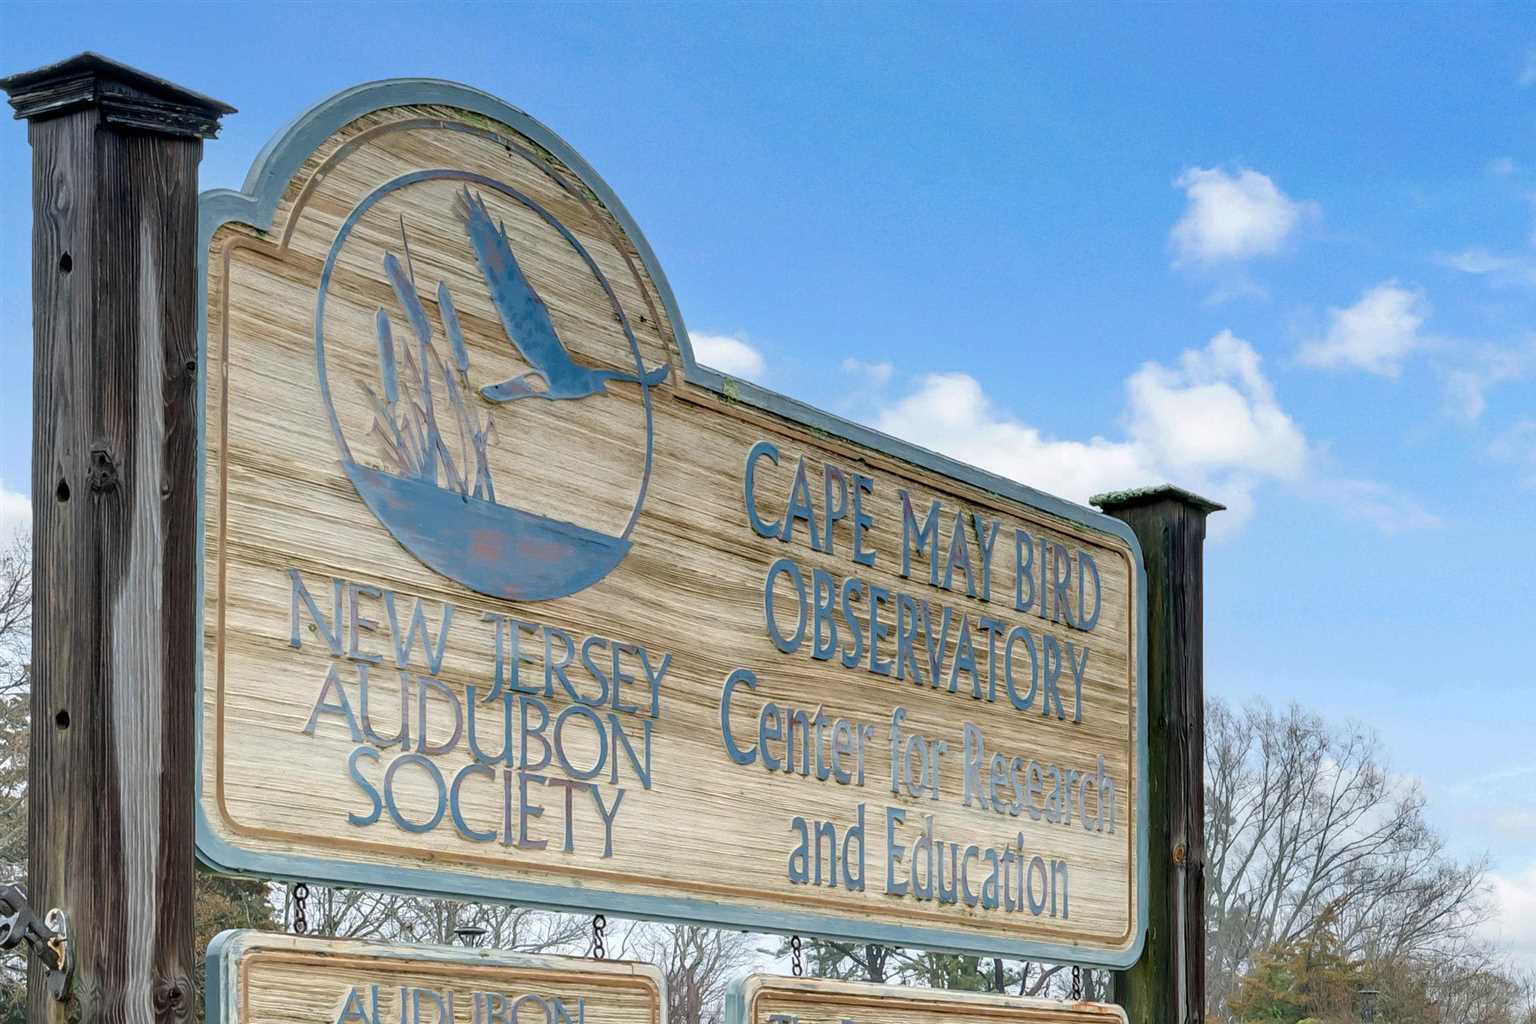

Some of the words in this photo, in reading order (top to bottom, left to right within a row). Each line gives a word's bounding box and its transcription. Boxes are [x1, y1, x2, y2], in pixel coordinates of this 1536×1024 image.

[744, 440, 877, 567] CAPE
[900, 489, 1000, 603] MAY
[1015, 528, 1101, 633] BIRD
[288, 568, 454, 675] NEW
[481, 611, 672, 718] JERSEY
[764, 557, 1089, 724] OBSERVATORY
[302, 663, 653, 790] AUDUBON
[720, 668, 874, 787] Center
[890, 706, 948, 801] for
[962, 721, 1117, 835] Research
[347, 746, 626, 859] SOCIETY
[787, 803, 865, 892] and
[884, 806, 1069, 920] Education
